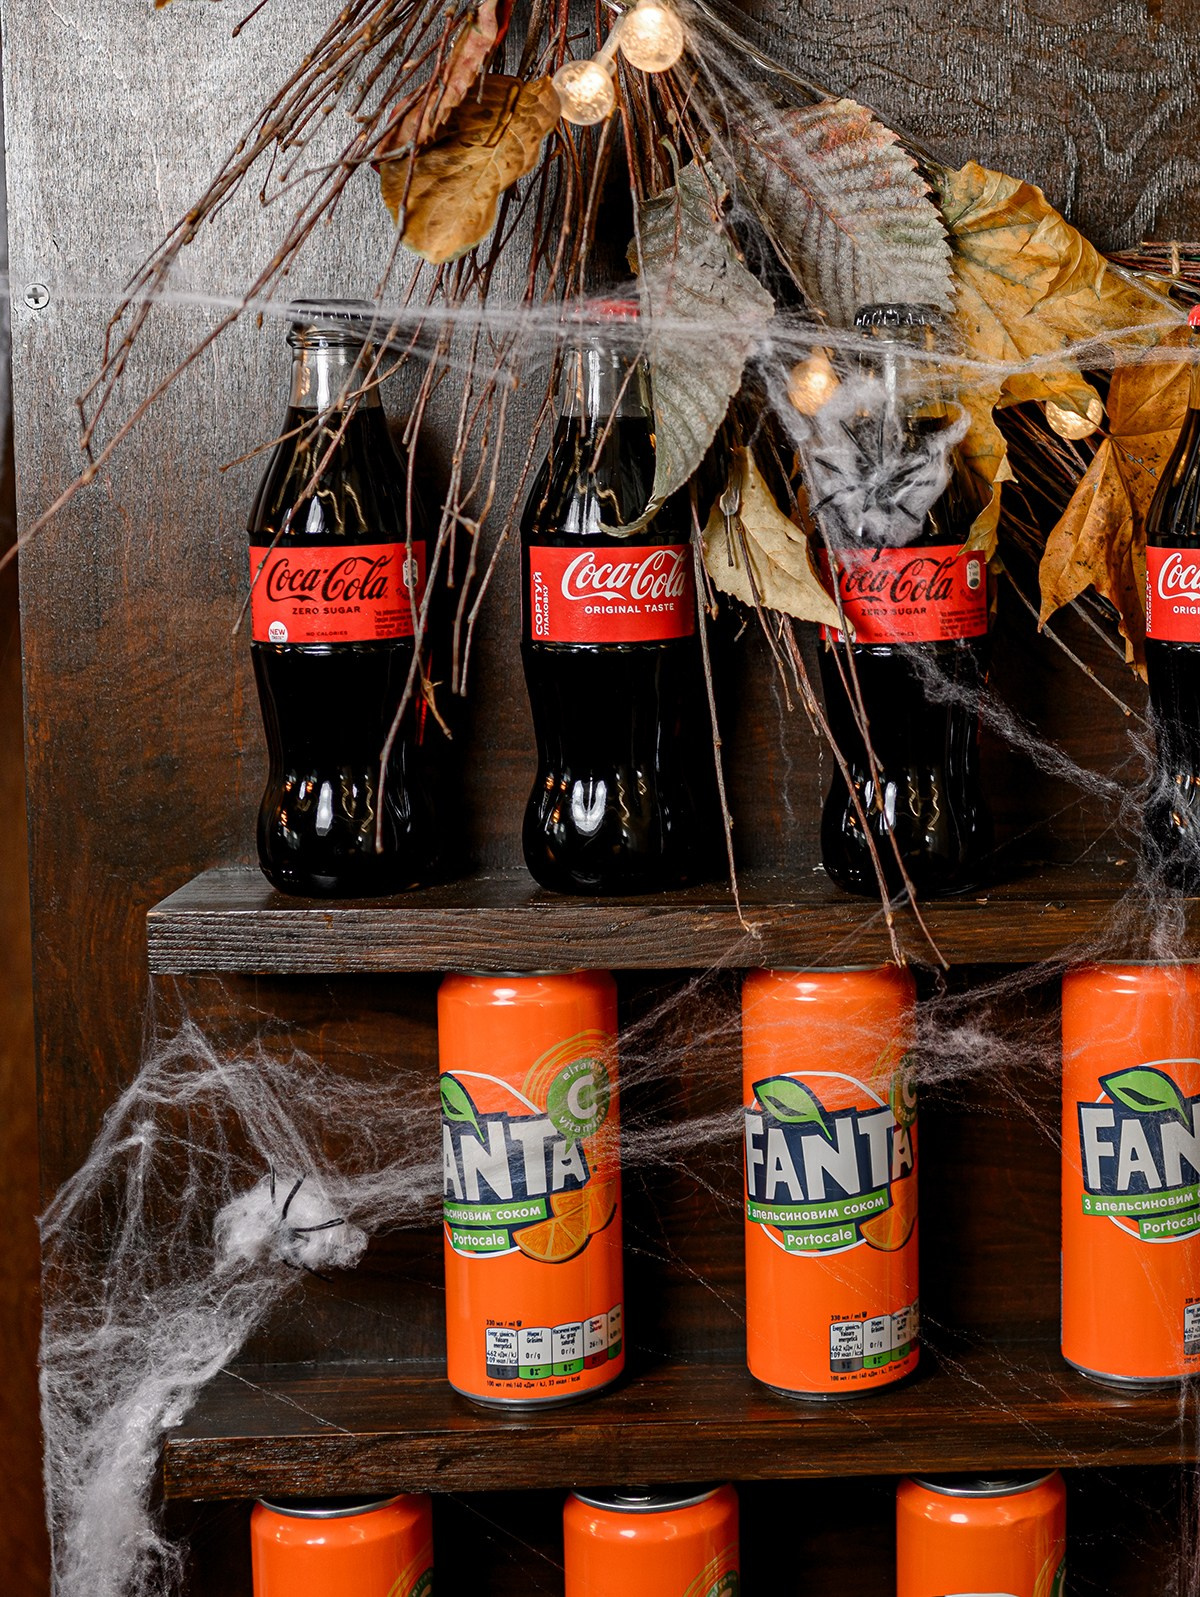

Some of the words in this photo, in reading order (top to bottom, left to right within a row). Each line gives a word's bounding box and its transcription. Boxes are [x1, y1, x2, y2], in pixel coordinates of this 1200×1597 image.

[267, 554, 394, 603] Coca-Cola
[561, 549, 687, 601] Coca-Cola
[292, 607, 319, 615] ZERO
[323, 605, 361, 614] SUGAR
[533, 571, 543, 636] СОРТУЙ
[584, 604, 642, 614] ORIGINAL
[644, 602, 675, 613] TASTE
[861, 608, 887, 616] ZERO
[891, 607, 927, 616] SUGAR
[269, 628, 286, 637] NEW
[745, 1109, 914, 1202] FANTA
[752, 1207, 839, 1222] апельсиновим
[843, 1197, 885, 1216] соком
[1095, 1193, 1194, 1212] апельсиновим
[496, 1206, 542, 1220] соком
[453, 1232, 506, 1247] Portocale
[786, 1227, 854, 1248] Portocale
